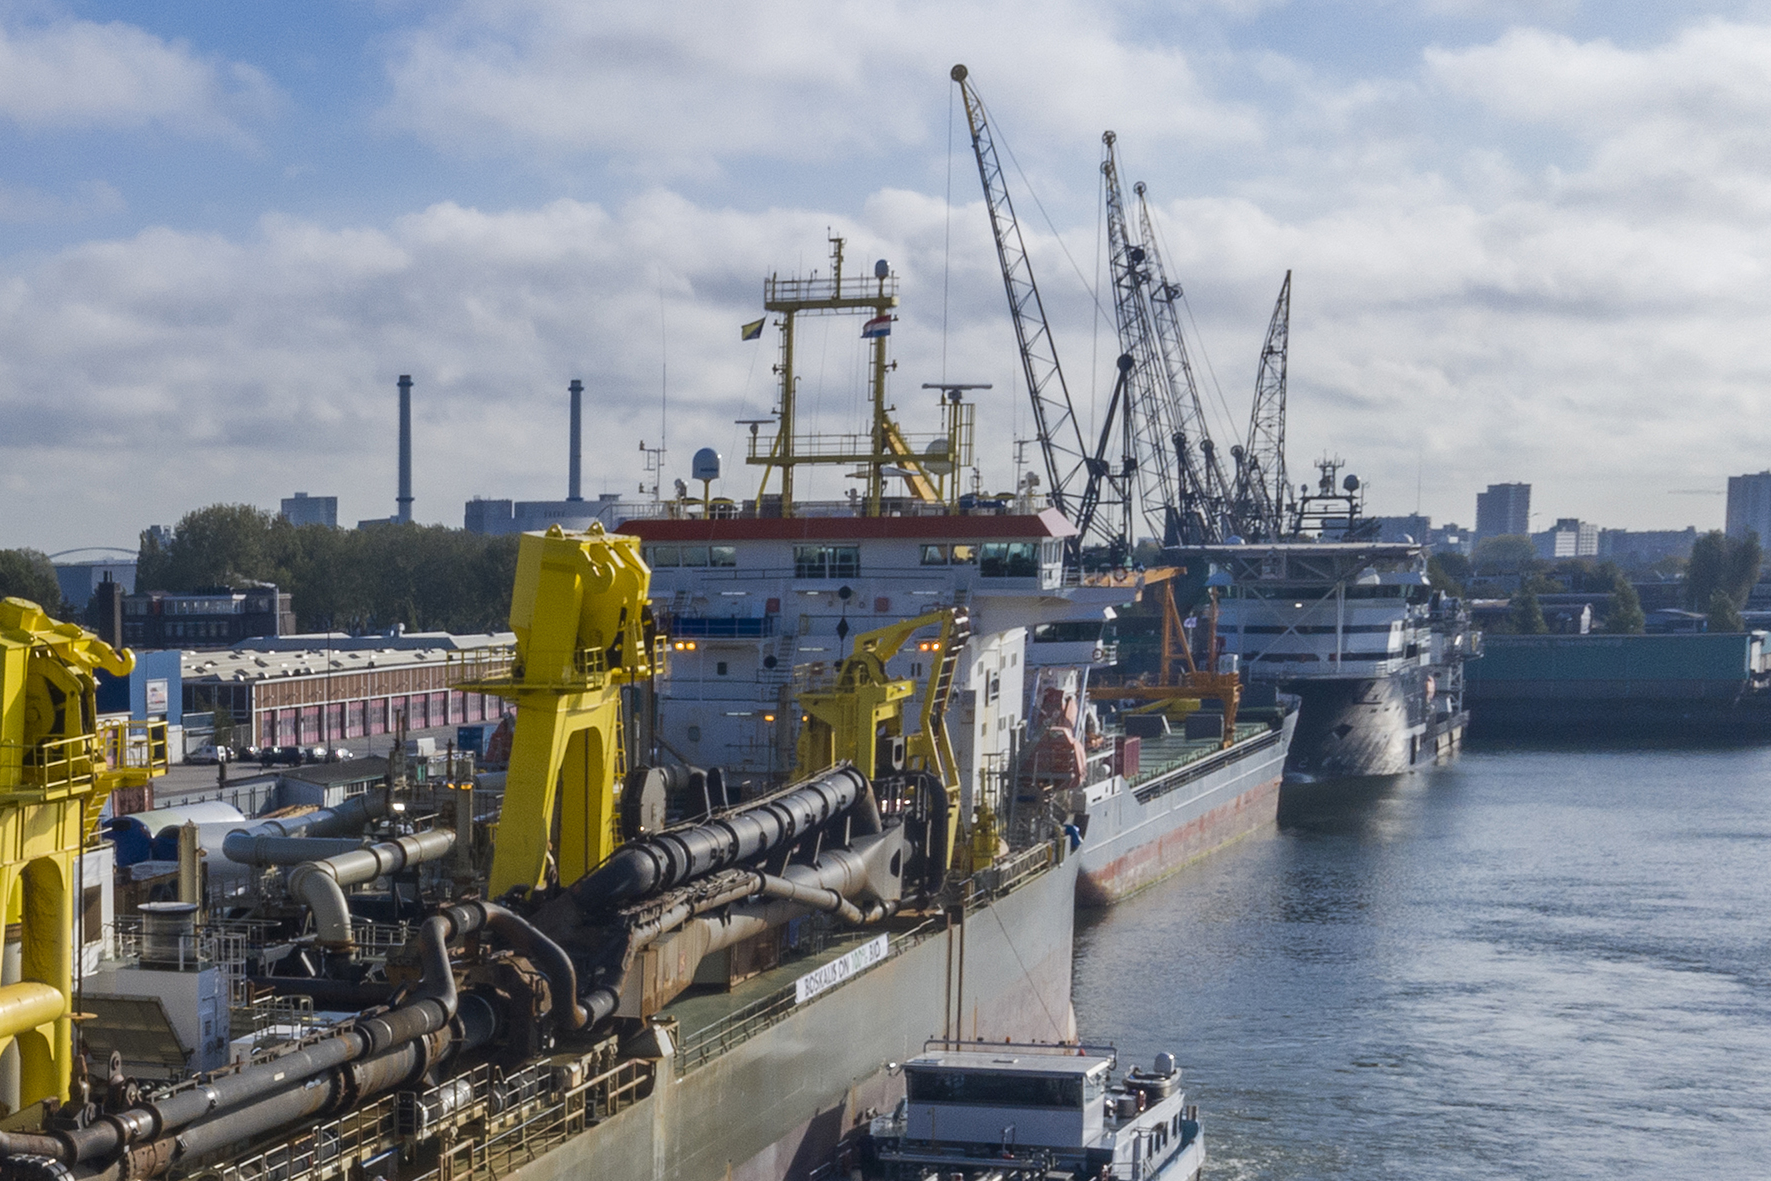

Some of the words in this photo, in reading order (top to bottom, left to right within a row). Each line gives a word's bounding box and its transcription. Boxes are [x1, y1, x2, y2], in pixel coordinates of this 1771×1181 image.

[804, 963, 838, 997] BOSKALIS
[838, 957, 850, 978] ON
[869, 941, 882, 962] BIO
